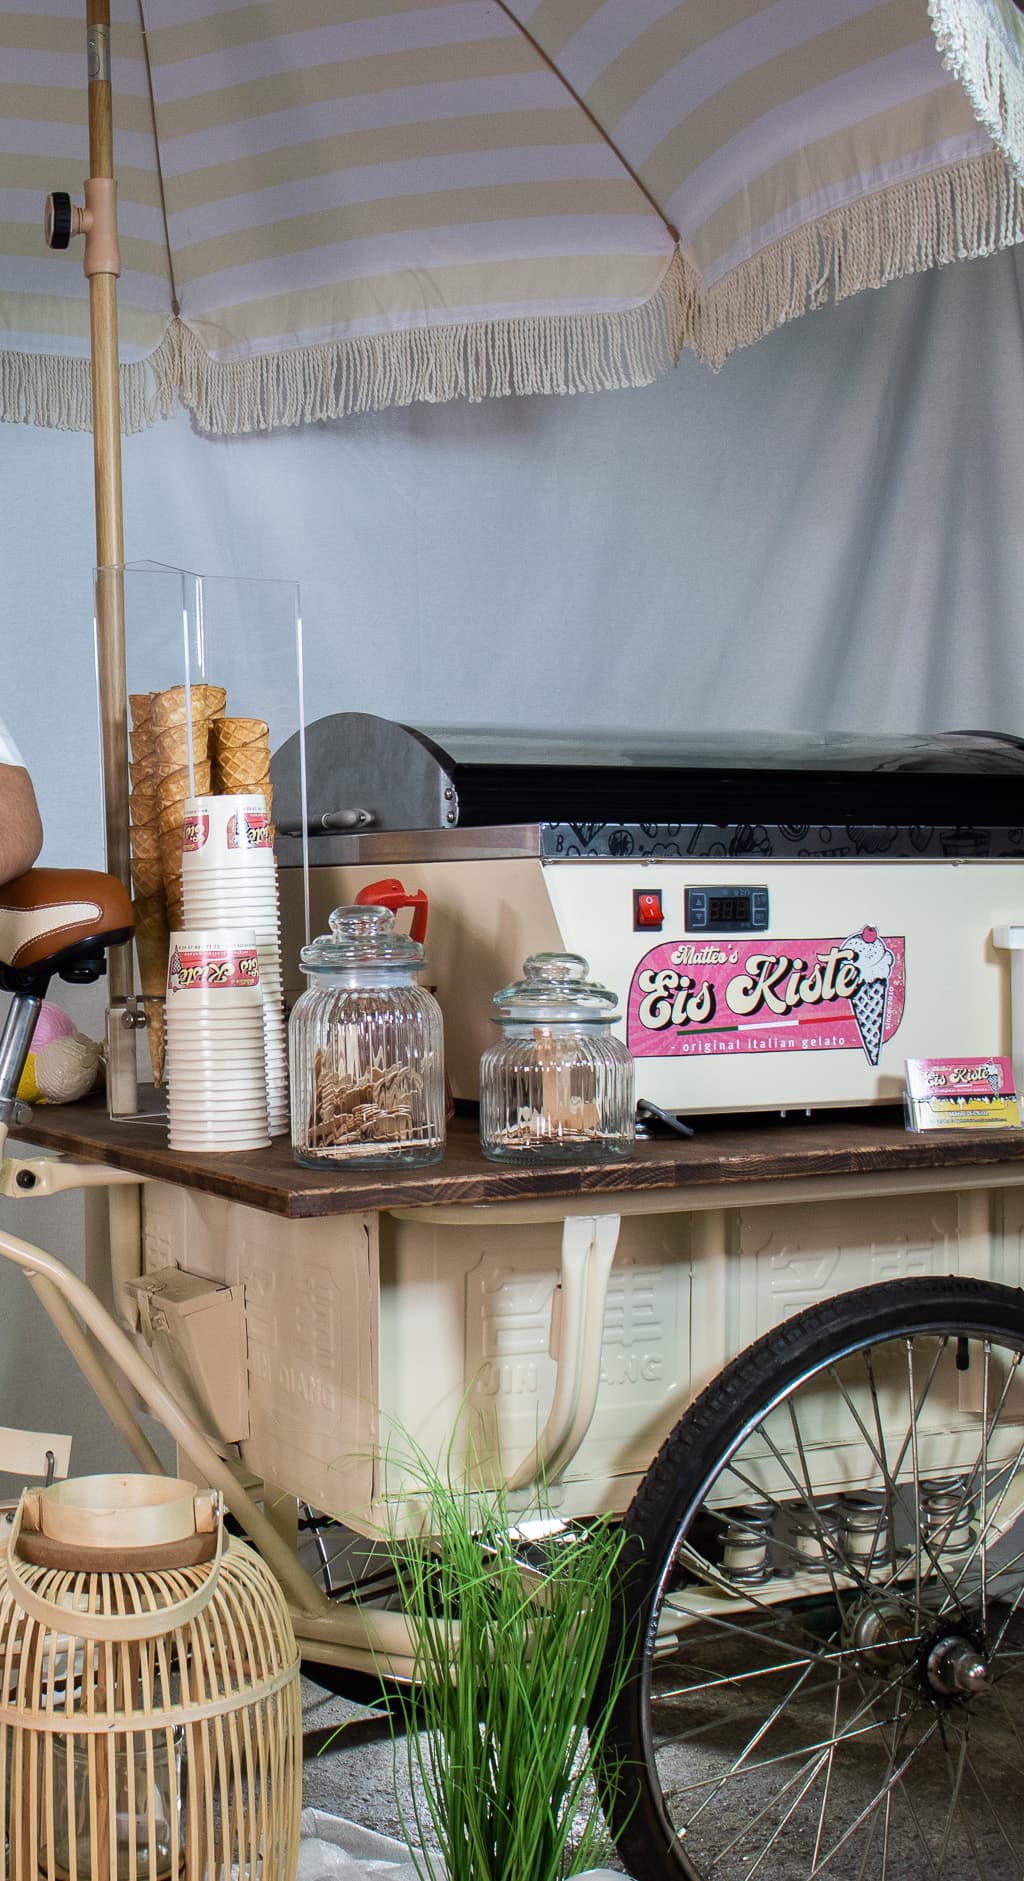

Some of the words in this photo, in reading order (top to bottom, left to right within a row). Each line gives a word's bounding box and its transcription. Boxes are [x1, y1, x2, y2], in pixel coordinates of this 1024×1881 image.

[671, 944, 738, 965] Matteo's
[638, 968, 715, 1030] Eis
[725, 946, 861, 1016] Kiste
[682, 1039, 740, 1053] original
[748, 1036, 795, 1049] italian
[802, 1036, 845, 1049] gelato
[949, 1066, 990, 1084] Kiste
